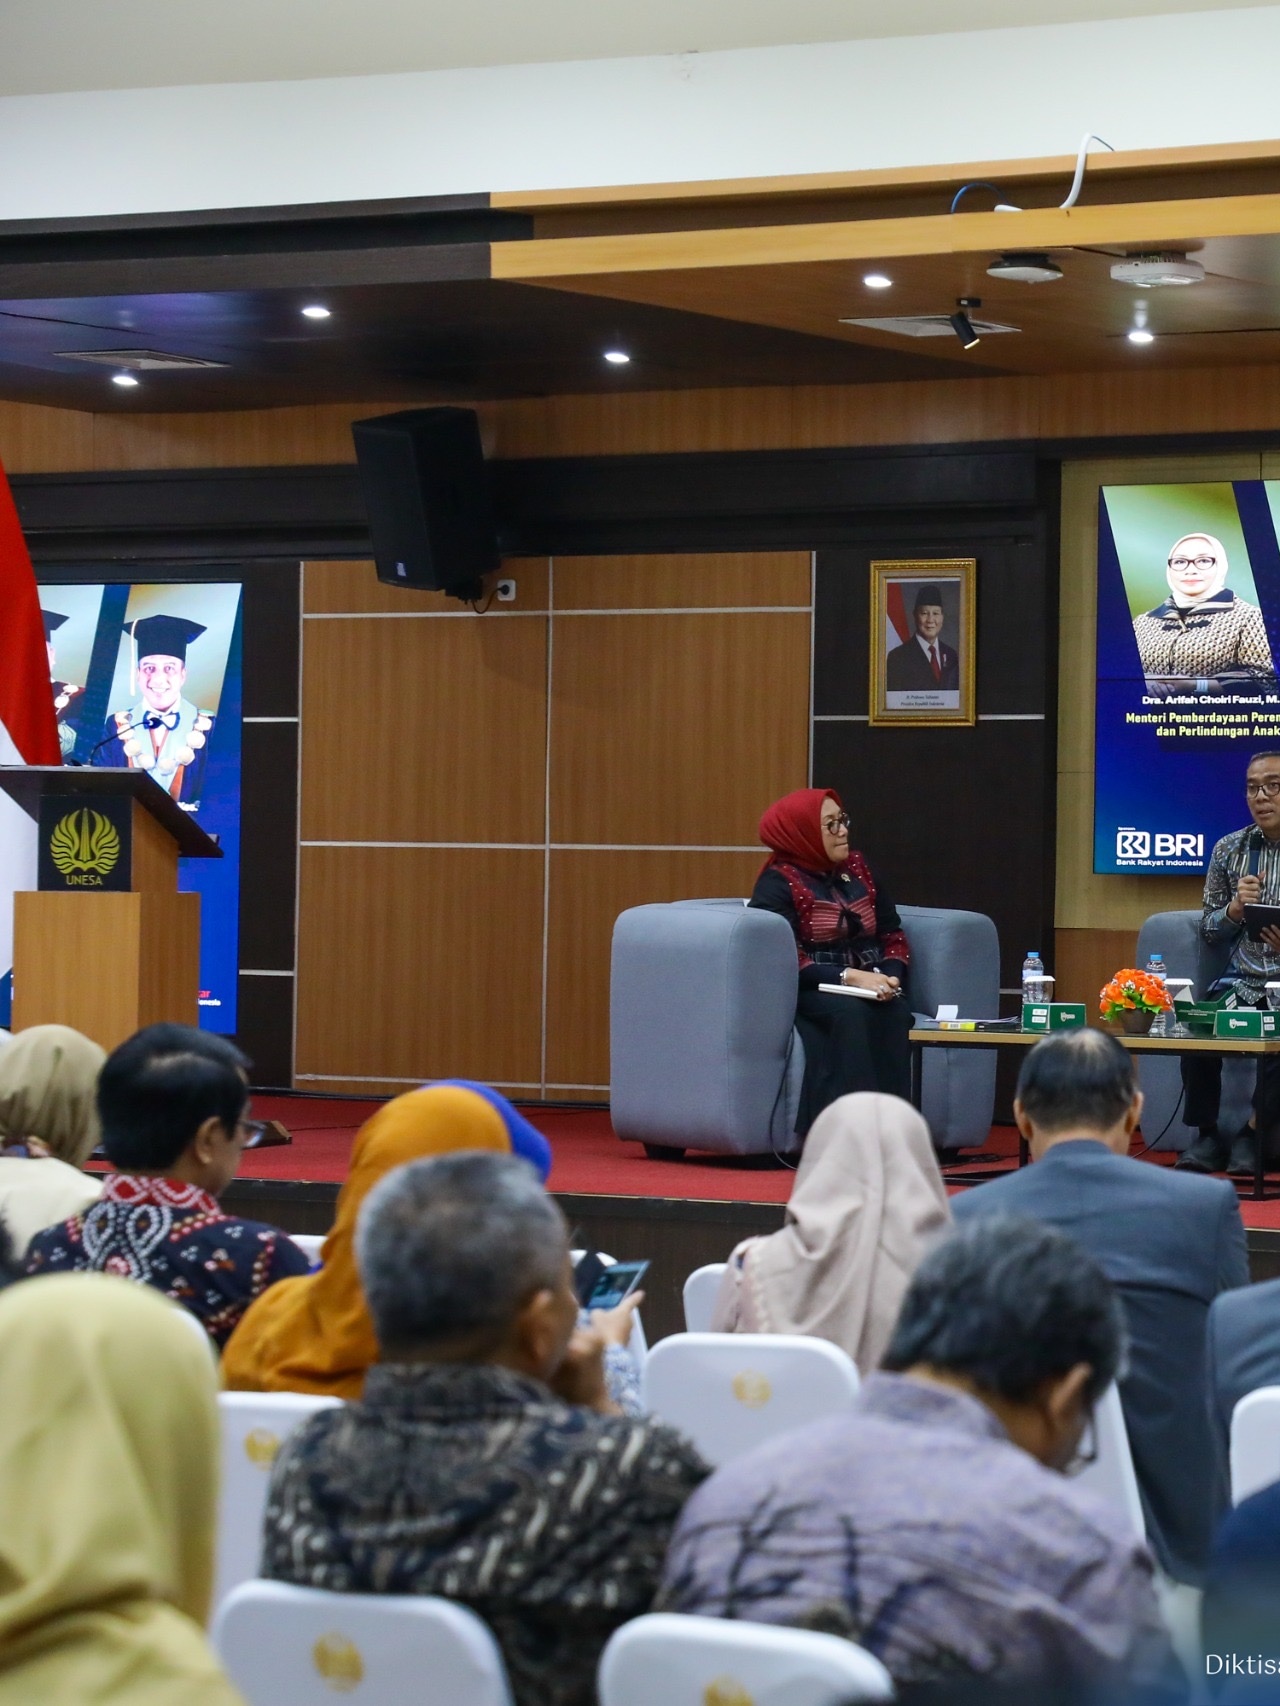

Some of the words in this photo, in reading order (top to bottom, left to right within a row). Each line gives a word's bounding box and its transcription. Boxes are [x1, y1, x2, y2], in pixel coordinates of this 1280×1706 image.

[1142, 696, 1163, 705] Dra.
[1165, 696, 1199, 704] Arifah
[1232, 695, 1264, 705] Fauzi,
[1126, 713, 1166, 723] Menteri
[1169, 712, 1248, 724] Pemberdayaan
[1156, 727, 1176, 736] dan
[1179, 726, 1250, 738] Perlindungan
[1253, 725, 1280, 736] Anak
[1155, 834, 1203, 856] BRI
[66, 875, 103, 885] UNESA
